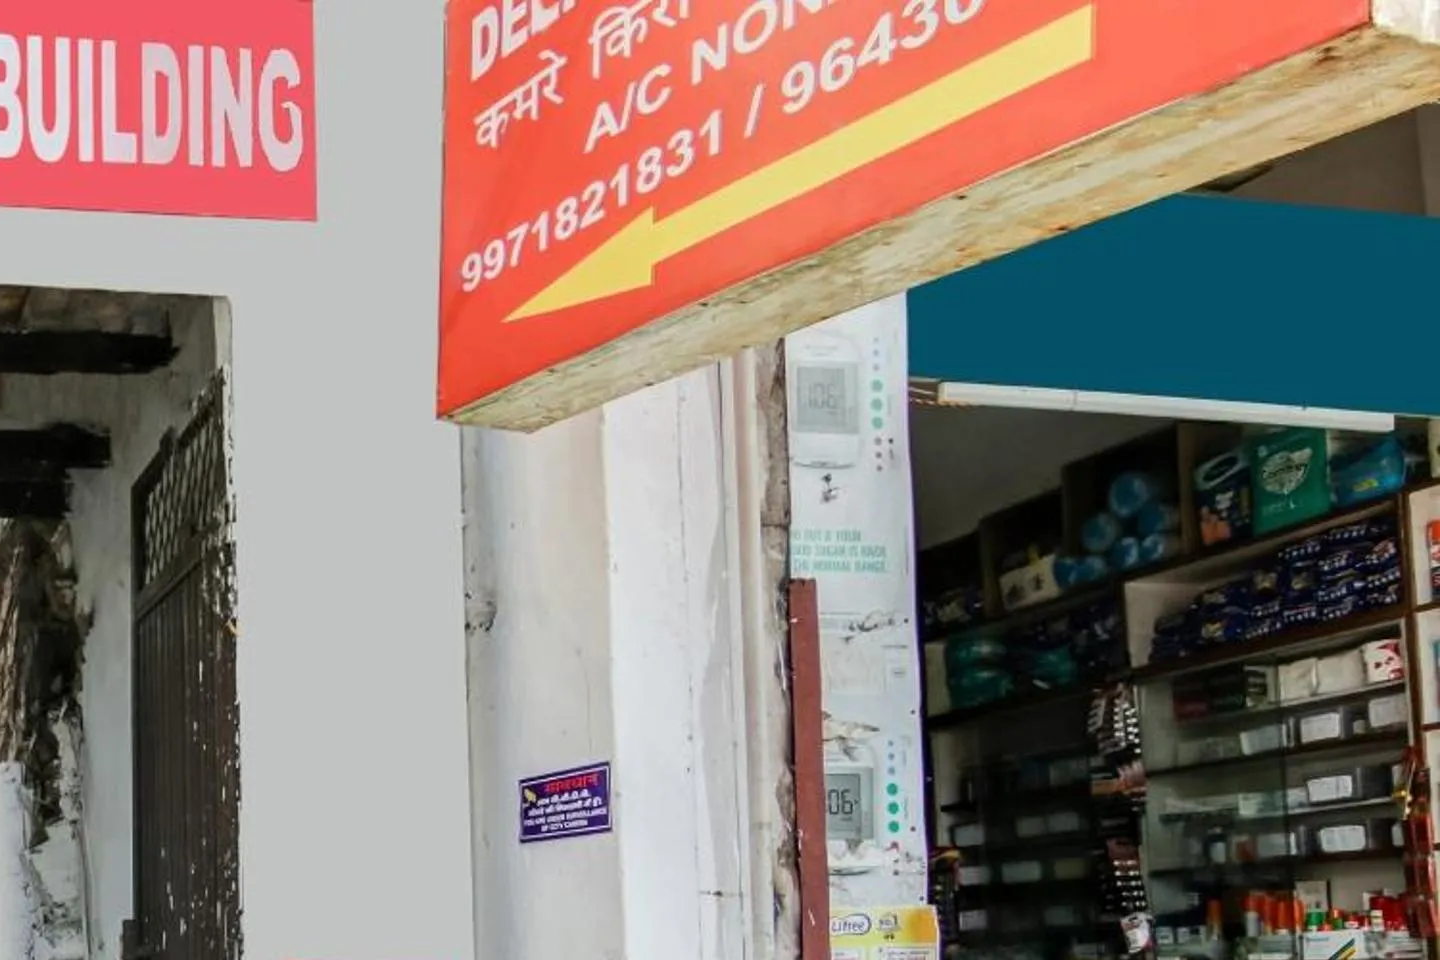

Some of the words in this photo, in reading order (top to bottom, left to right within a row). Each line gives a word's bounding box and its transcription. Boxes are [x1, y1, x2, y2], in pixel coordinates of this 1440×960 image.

[474, 50, 567, 148] कमरे
[584, 64, 671, 153] A/C
[461, 110, 722, 292] 9971821831
